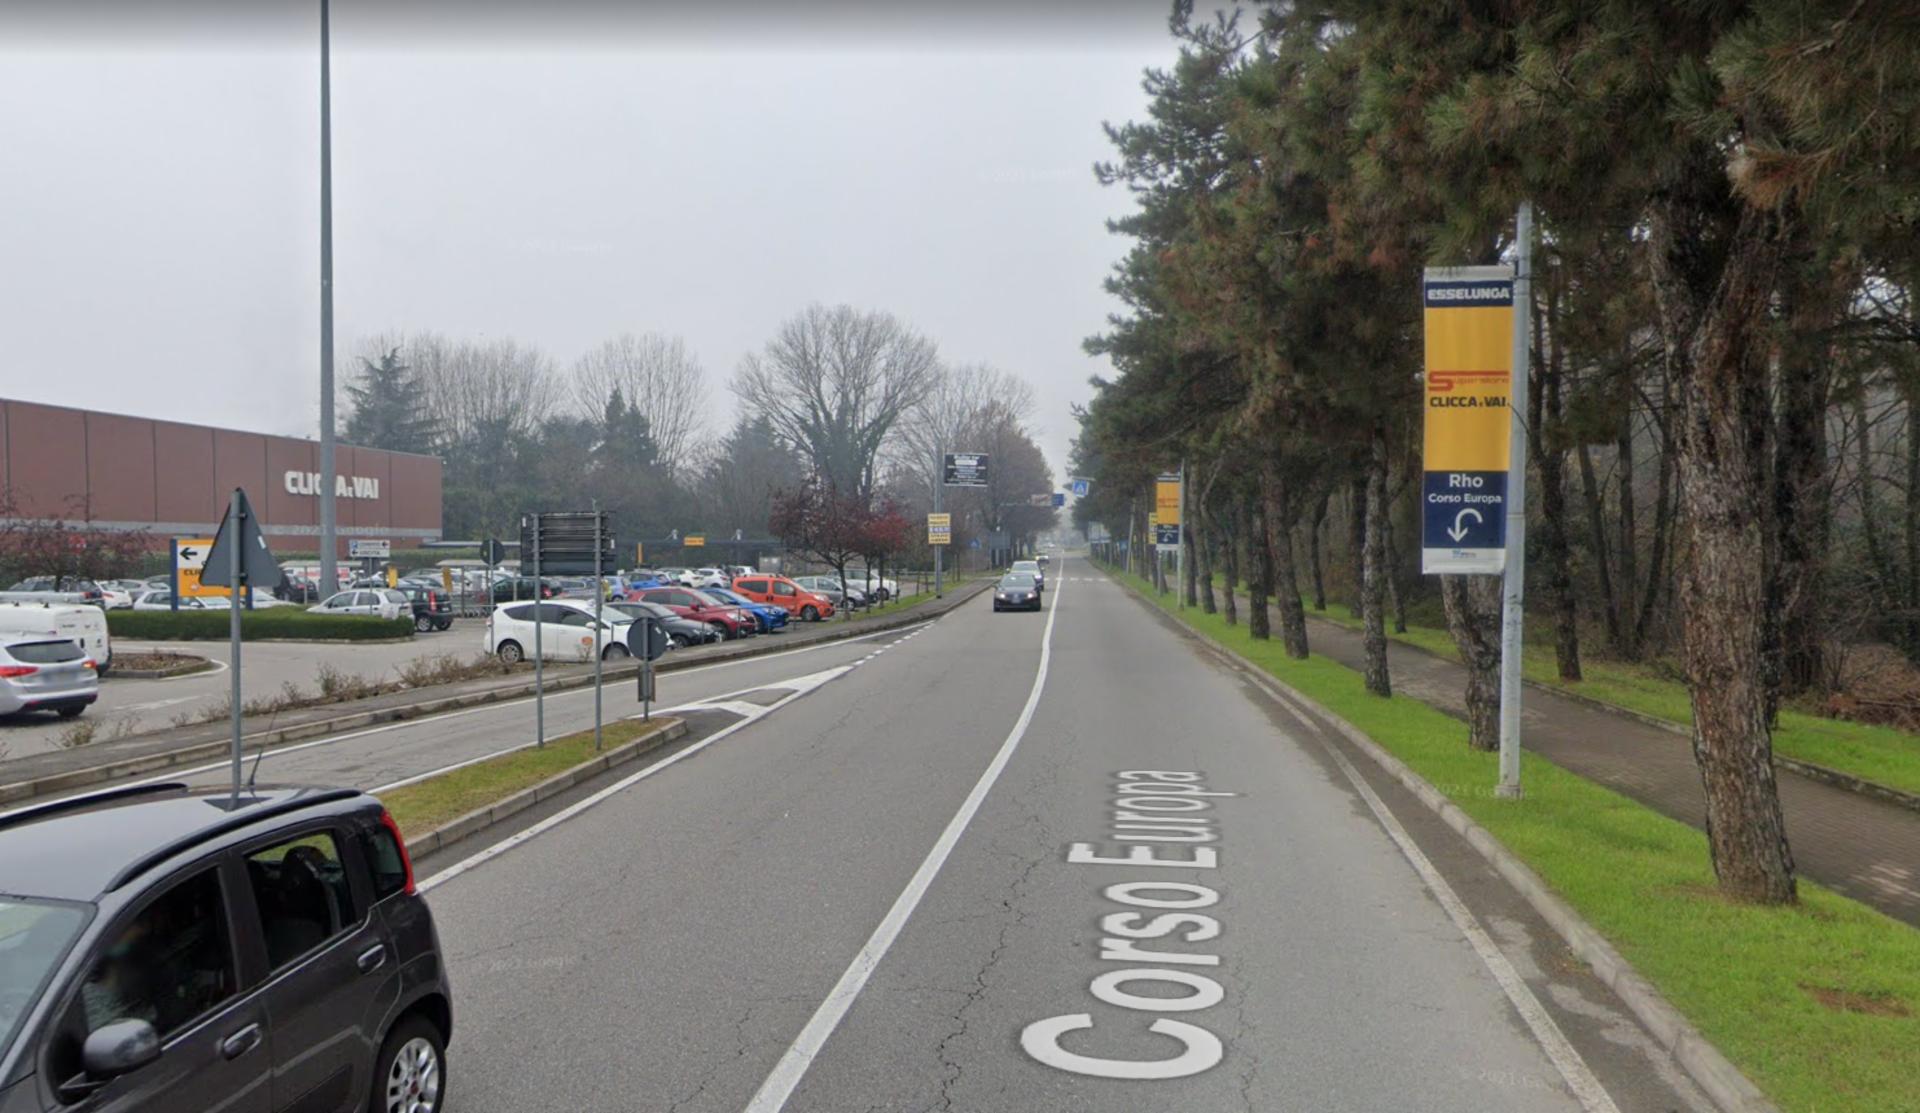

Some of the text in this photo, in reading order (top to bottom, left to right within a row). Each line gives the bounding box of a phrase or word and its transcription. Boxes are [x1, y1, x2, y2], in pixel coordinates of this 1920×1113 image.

[1427, 287, 1510, 300] ESSELUNGA
[1429, 396, 1478, 408] CLICCA
[1448, 473, 1484, 488] Rho
[1428, 493, 1503, 505] Corso Europa
[1021, 770, 1237, 1080] Corso Europa
